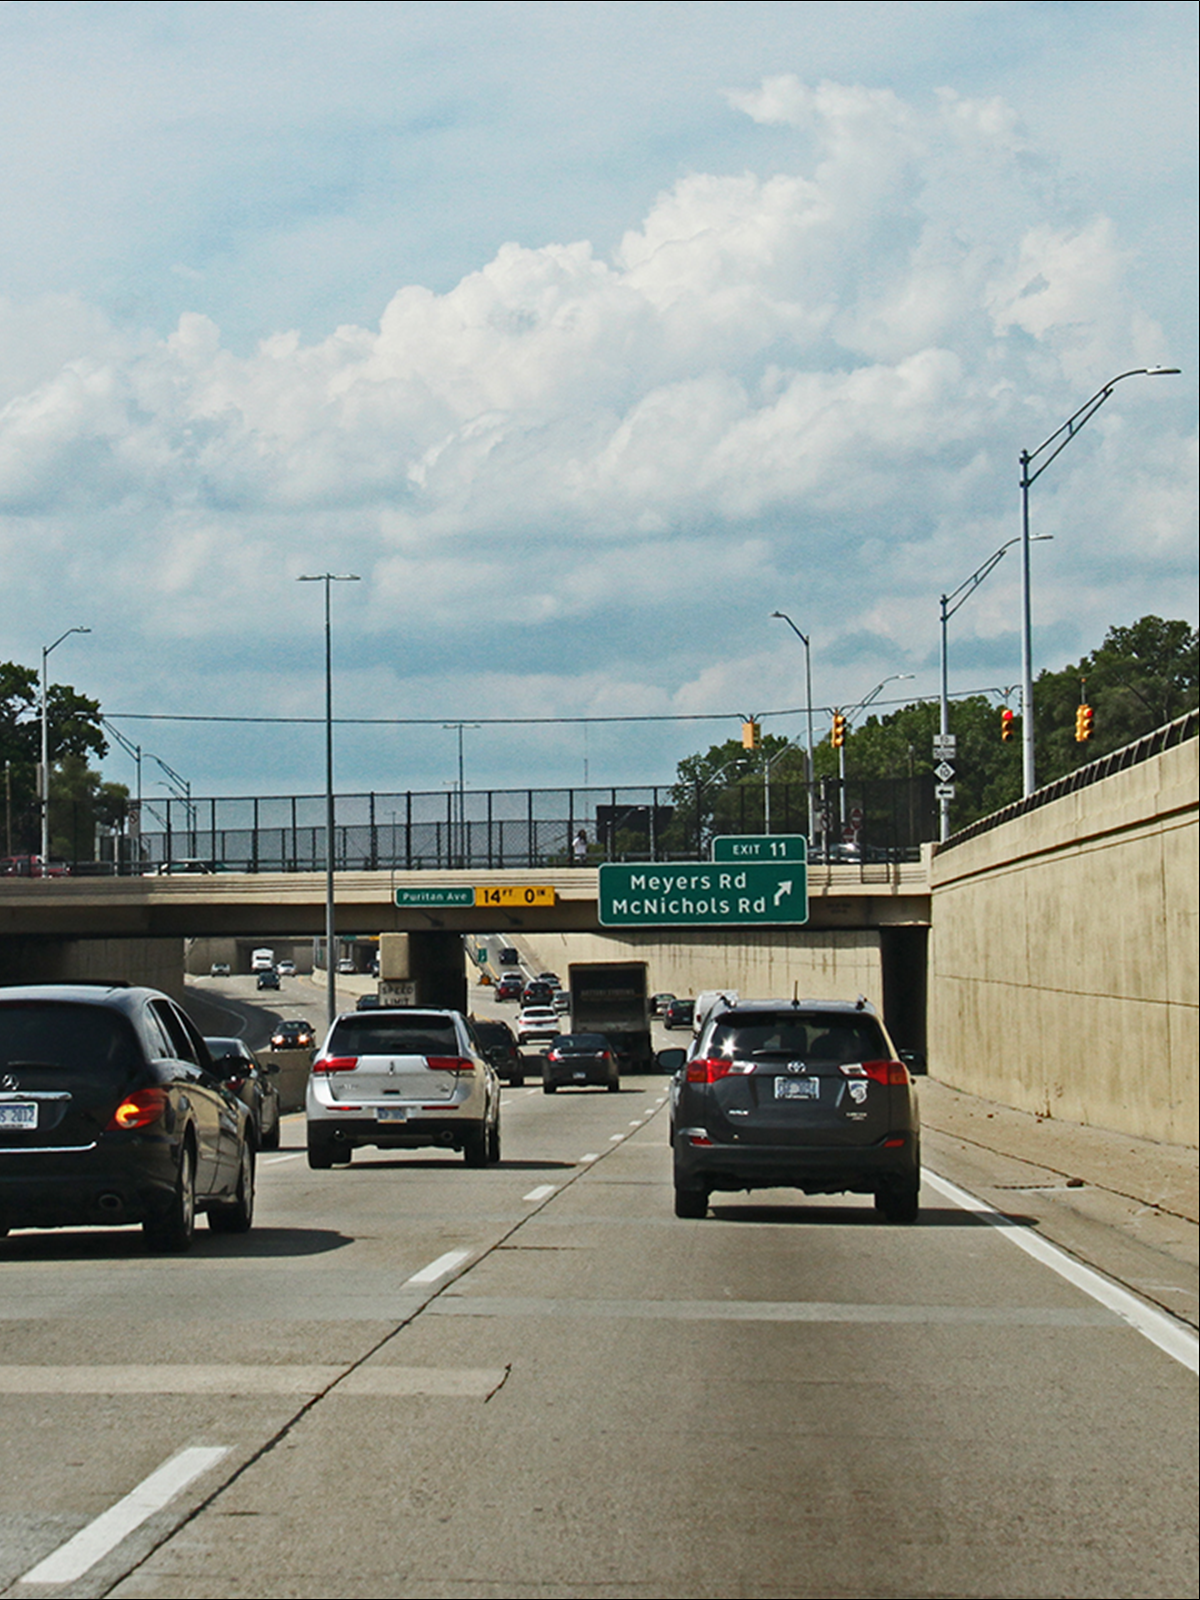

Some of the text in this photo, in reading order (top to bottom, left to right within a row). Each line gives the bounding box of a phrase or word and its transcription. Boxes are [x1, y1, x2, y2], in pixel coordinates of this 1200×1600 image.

[939, 768, 951, 778] 10
[732, 842, 787, 857] EXIT 11
[630, 872, 747, 894] Meyers Rd
[402, 892, 468, 901] Puritan Ave
[612, 896, 766, 915] McNichols Rd
[382, 984, 414, 995] SPEED
[384, 997, 409, 1006] LIMIT
